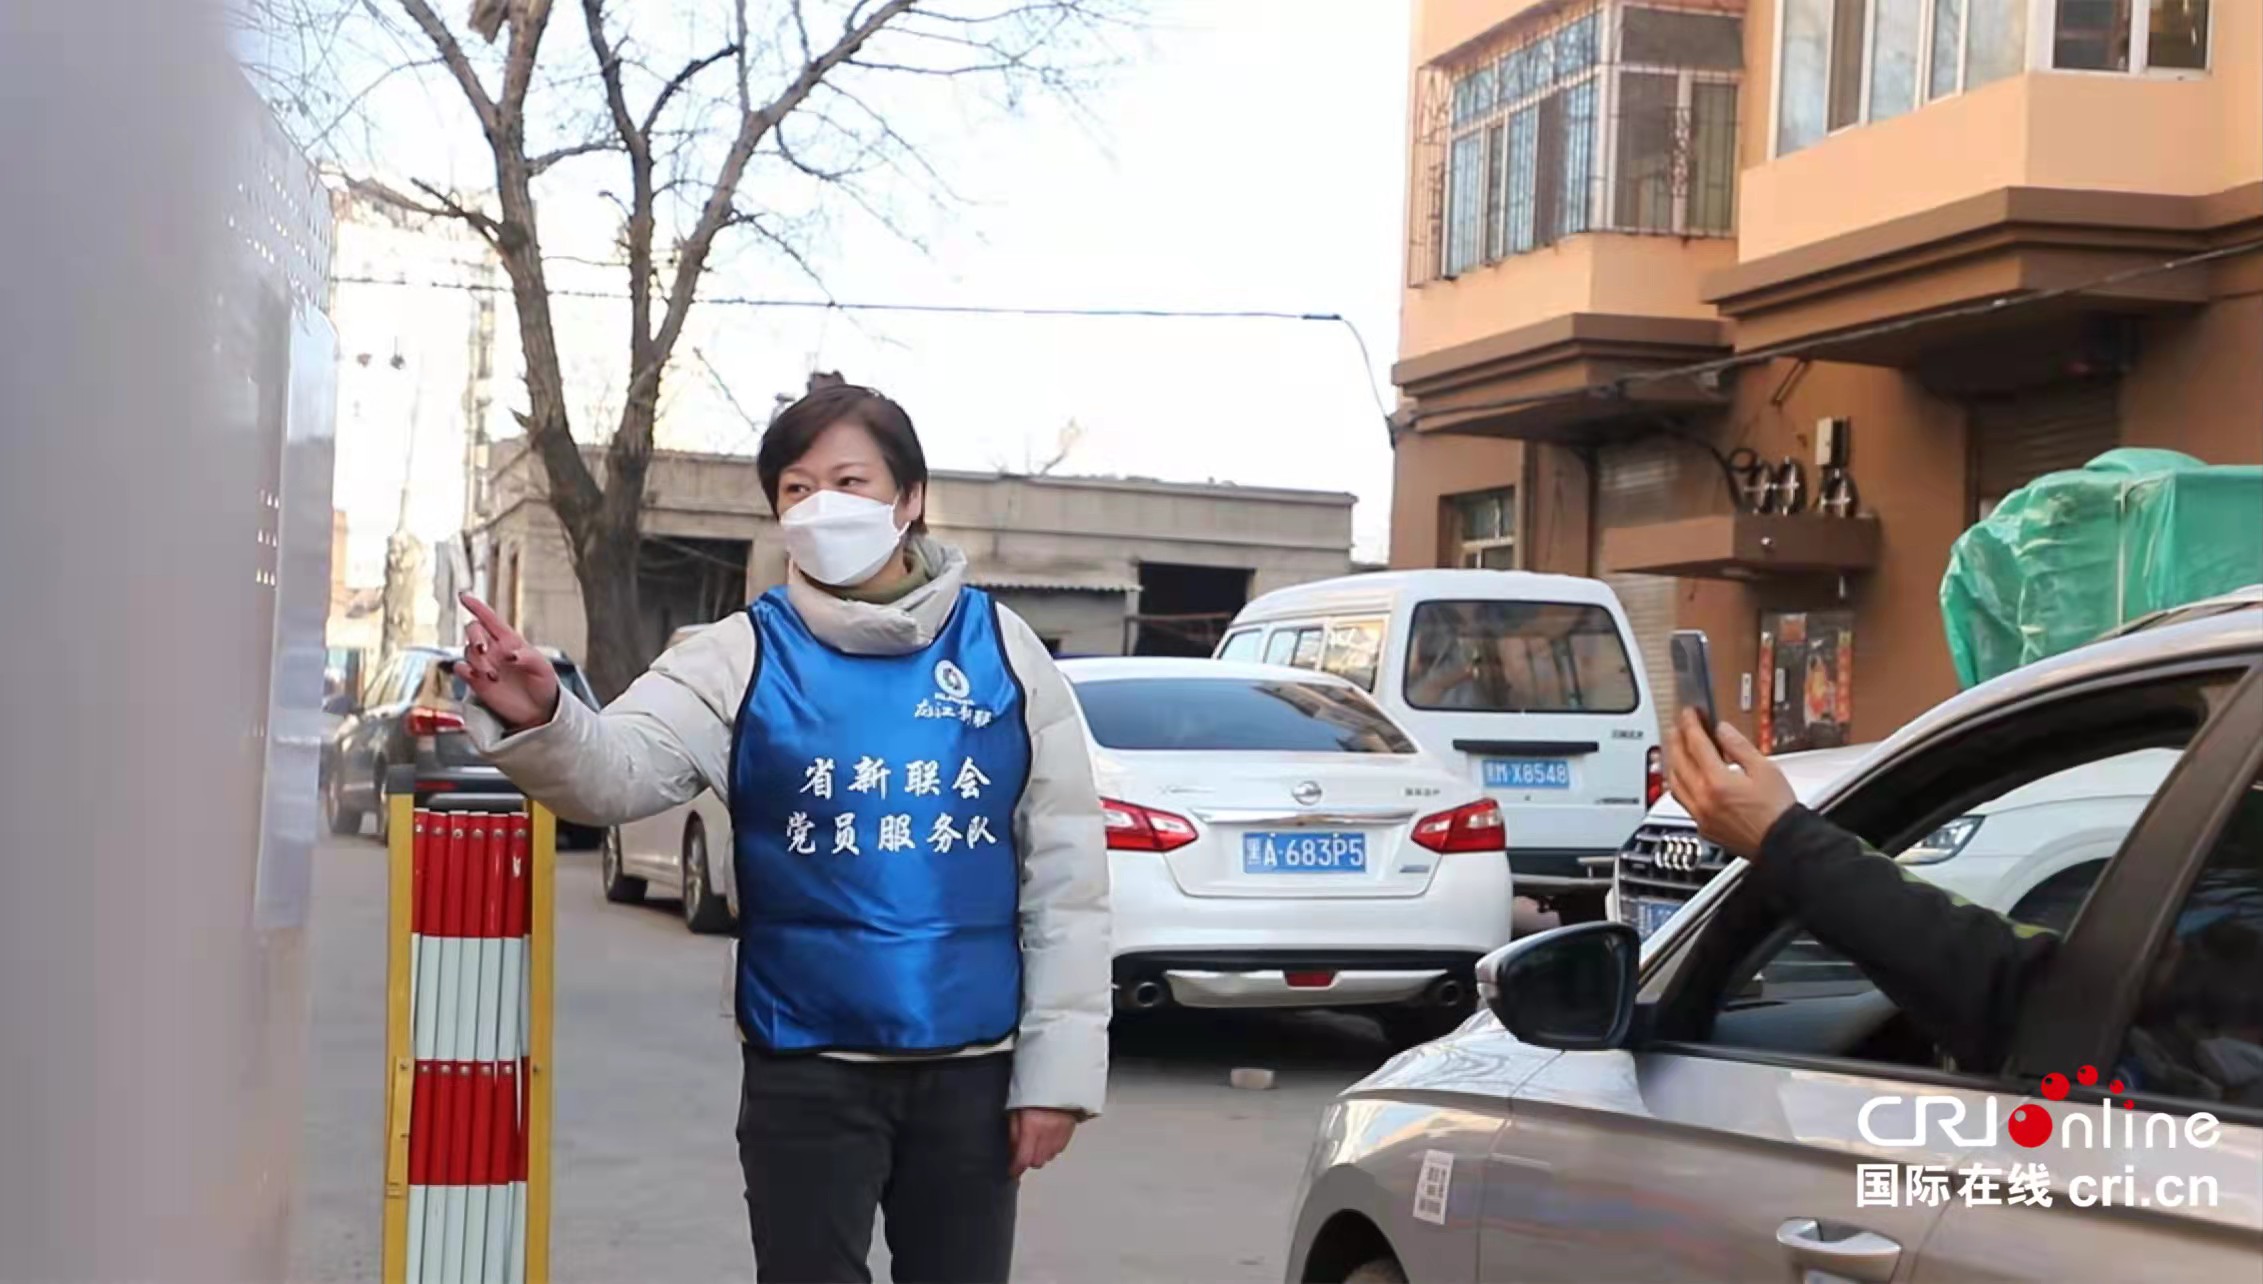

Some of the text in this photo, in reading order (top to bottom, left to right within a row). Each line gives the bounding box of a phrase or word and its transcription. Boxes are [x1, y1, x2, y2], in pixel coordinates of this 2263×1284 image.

[799, 756, 991, 799] 省新联会
[786, 811, 997, 854] 党员服务队
